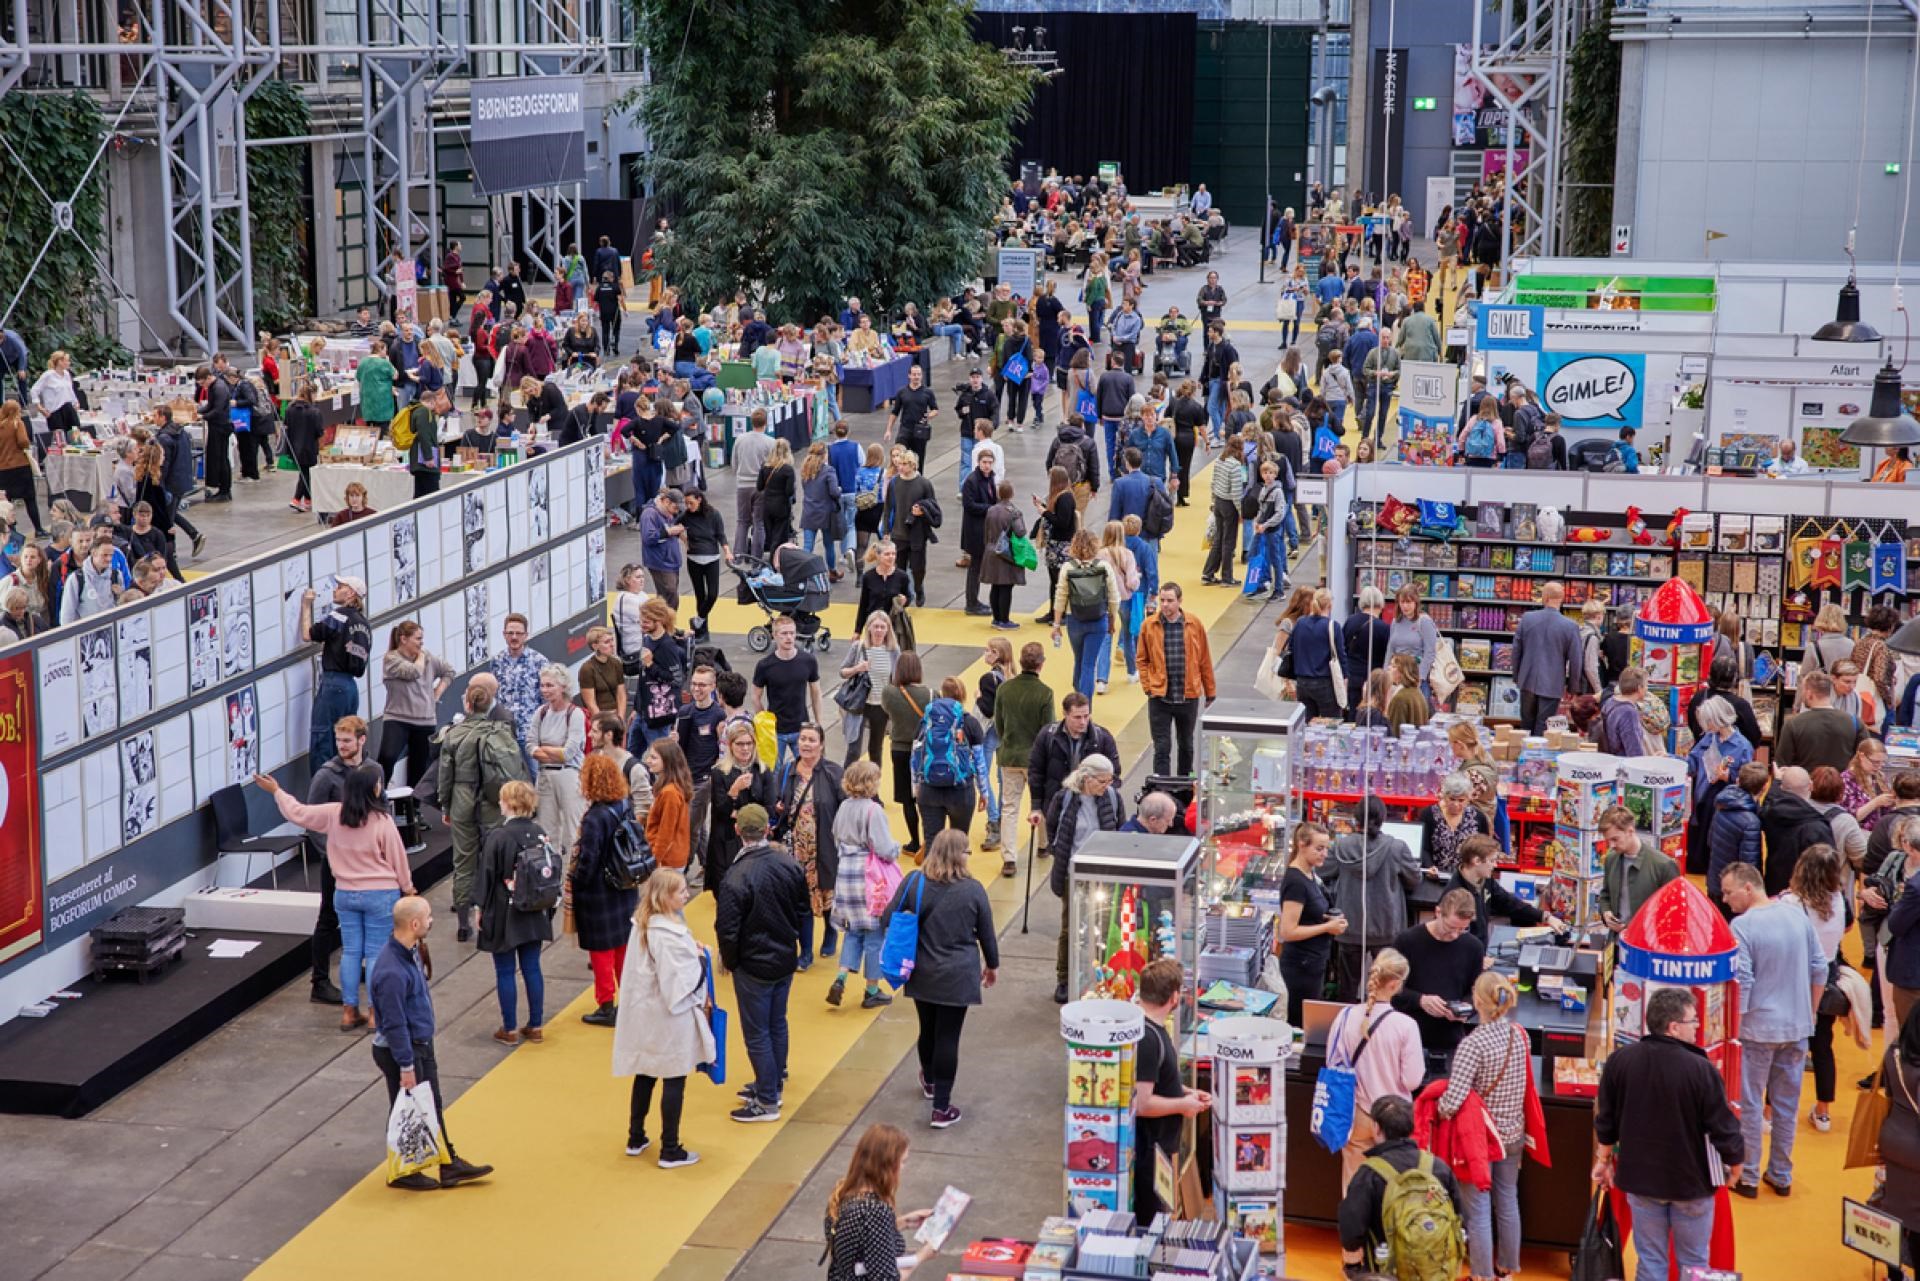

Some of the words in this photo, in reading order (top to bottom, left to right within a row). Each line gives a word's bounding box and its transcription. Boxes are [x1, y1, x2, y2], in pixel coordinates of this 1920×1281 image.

[478, 92, 579, 120] BØRNEBOGSFORUM
[1490, 312, 1527, 336] GIMLE
[1415, 377, 1439, 398] GIMLE
[1551, 371, 1627, 404] GIMLE!
[1642, 624, 1680, 639] TINTIN
[1571, 769, 1603, 781] ZOOM
[1643, 775, 1675, 786] ZOOM
[49, 873, 102, 913] Præsenteret
[103, 865, 113, 883] af
[50, 894, 103, 933] BOGFORUM
[103, 874, 137, 903] COMICS
[1651, 958, 1713, 979] TINTIN
[1216, 1043, 1255, 1060] ZOOM
